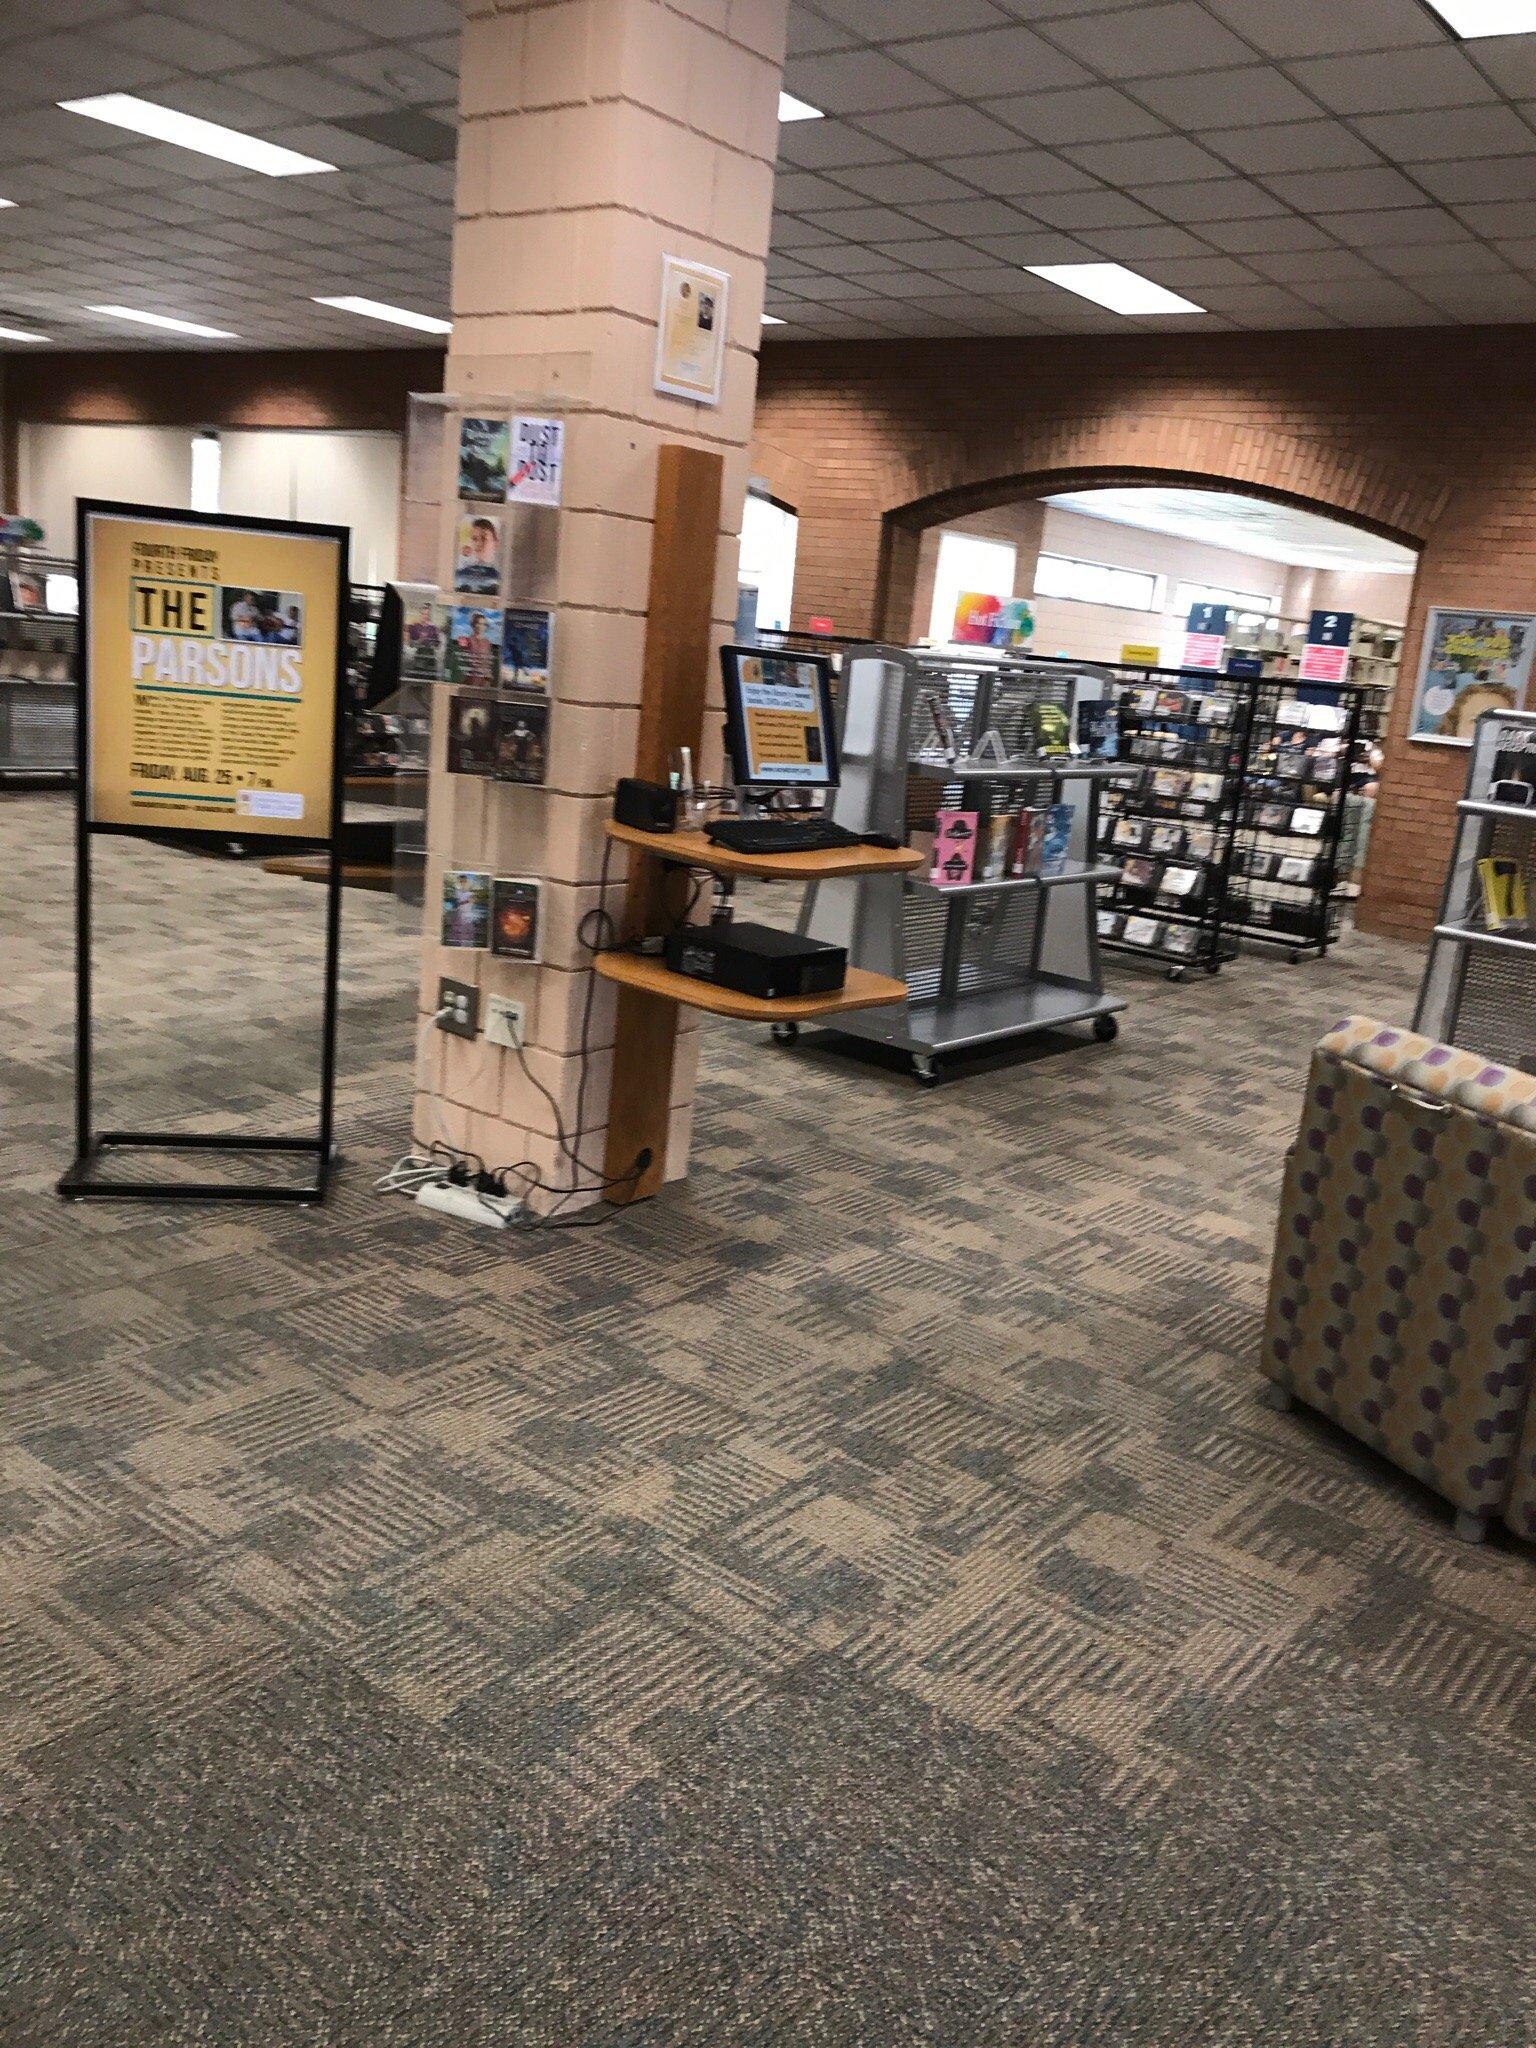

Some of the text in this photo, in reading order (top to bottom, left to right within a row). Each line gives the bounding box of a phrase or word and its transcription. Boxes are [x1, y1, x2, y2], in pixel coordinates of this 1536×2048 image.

[131, 558, 219, 580] PRESENTS
[137, 586, 207, 631] THE
[1323, 615, 1339, 628] 2
[130, 635, 303, 694] PARSONS
[215, 769, 233, 785] 25
